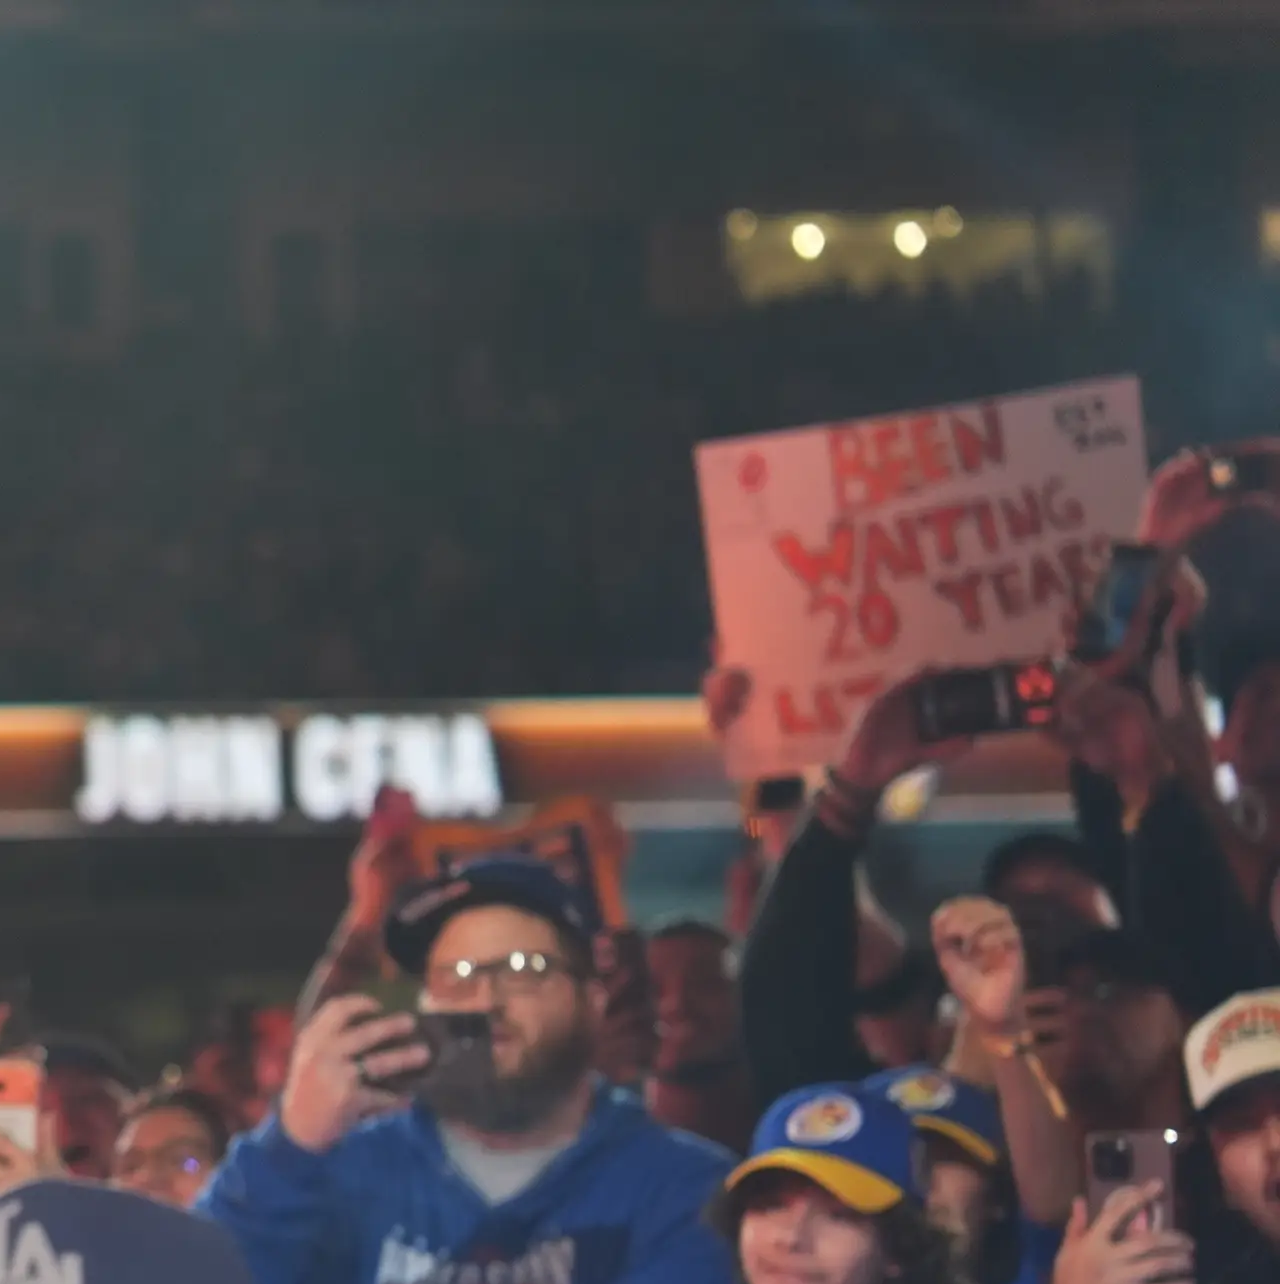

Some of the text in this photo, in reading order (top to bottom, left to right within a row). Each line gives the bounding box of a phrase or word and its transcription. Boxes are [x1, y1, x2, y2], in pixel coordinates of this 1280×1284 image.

[828, 401, 1005, 510] BEEN
[811, 592, 901, 661] 20
[75, 714, 282, 822] JOHN
